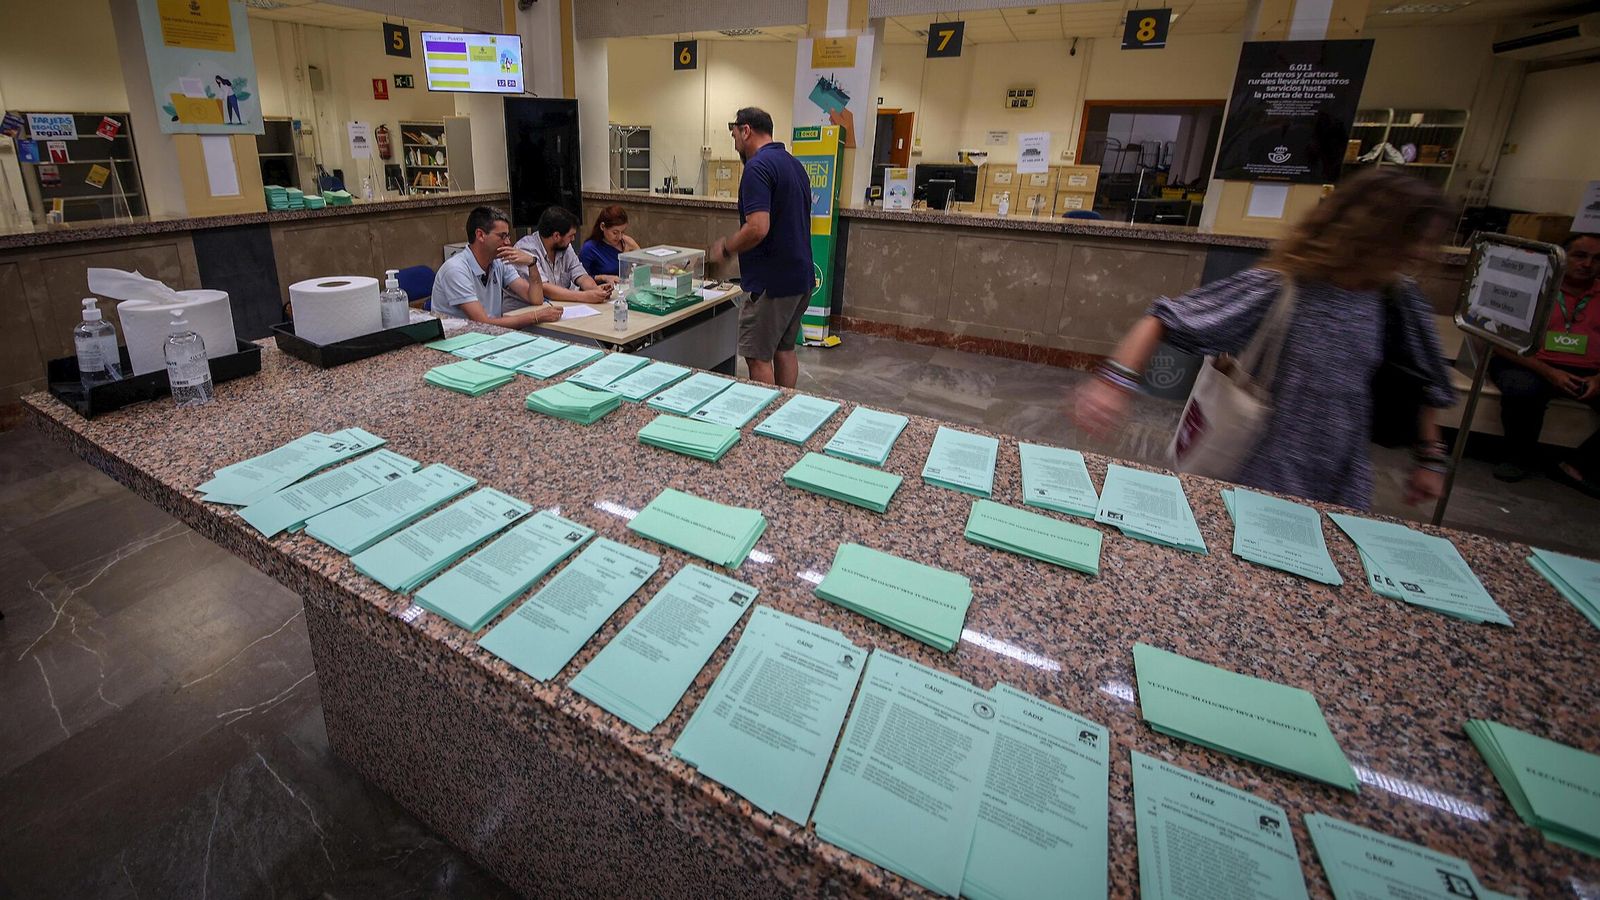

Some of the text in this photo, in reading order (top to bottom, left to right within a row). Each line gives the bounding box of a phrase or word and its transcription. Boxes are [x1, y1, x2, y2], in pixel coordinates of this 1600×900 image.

[1136, 16, 1156, 43] 8
[393, 31, 404, 50] 5
[937, 30, 955, 51] 7
[679, 47, 691, 65] 6
[1289, 63, 1313, 71] 6.011
[1277, 77, 1311, 85] llevarán
[1296, 72, 1304, 80] y
[1266, 84, 1327, 92] servicios hasta
[1262, 92, 1291, 100] puerta
[804, 163, 829, 175] IEN
[1553, 336, 1580, 345] VOX
[908, 663, 932, 677] ELECCIONES
[924, 683, 944, 695] CÁDIZ
[1002, 686, 1029, 702] ELECCIONES
[1023, 709, 1044, 722] CÁDIZ
[1266, 717, 1316, 737] ELECCIONES
[1159, 763, 1192, 781] ELECCIONES
[1201, 780, 1237, 799] PARLAMENTO
[1190, 791, 1217, 806] CÁDIZ
